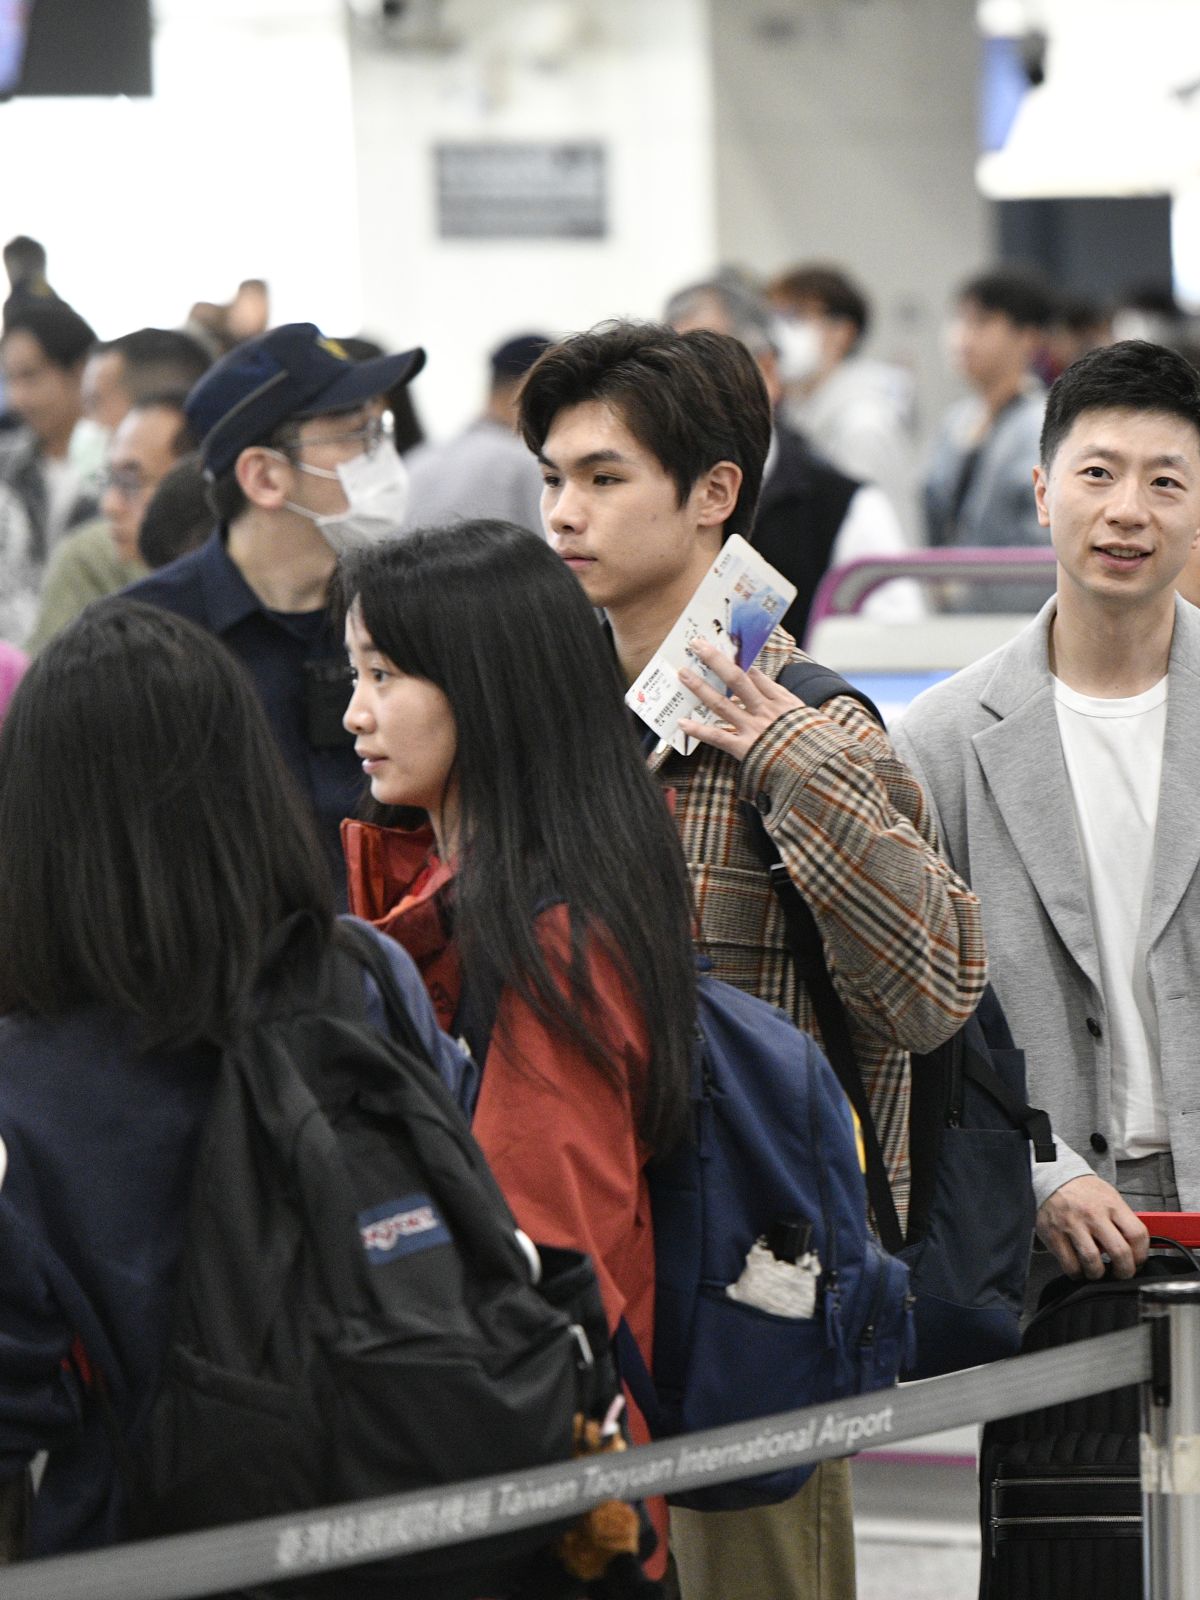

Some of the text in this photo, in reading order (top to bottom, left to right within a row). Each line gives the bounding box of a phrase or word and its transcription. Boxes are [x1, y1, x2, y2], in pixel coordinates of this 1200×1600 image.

[500, 1480, 579, 1517] Taiwan
[583, 1463, 674, 1502] Taoyuan
[675, 1415, 818, 1477] International
[817, 1407, 894, 1450] Airport
